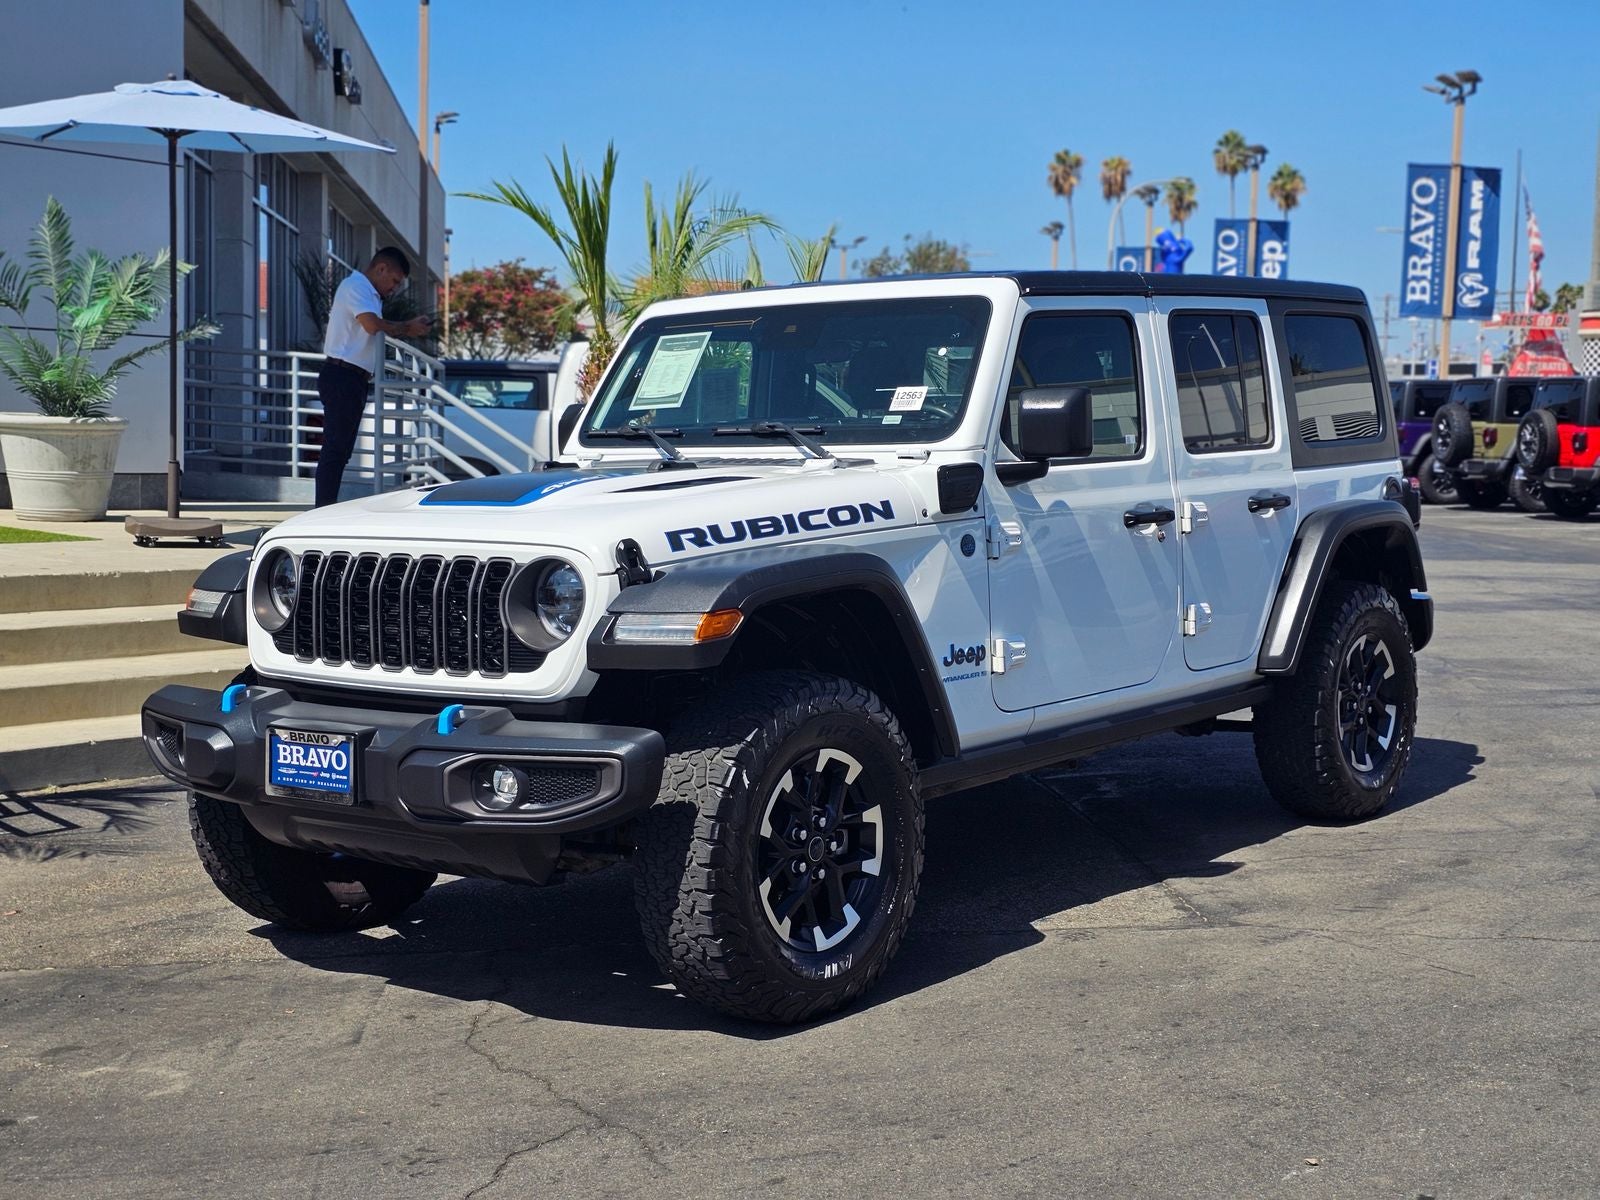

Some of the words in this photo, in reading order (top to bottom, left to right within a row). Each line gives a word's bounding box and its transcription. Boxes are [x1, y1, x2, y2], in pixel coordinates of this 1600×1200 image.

[1466, 180, 1484, 269] RAM
[1406, 177, 1437, 304] BRAVO
[895, 391, 923, 400] 12563
[664, 499, 896, 553] RUBICON
[943, 643, 987, 667] Jeep
[943, 671, 980, 683] WRANGLER
[289, 732, 329, 744] BRAVO
[277, 743, 347, 771] BRAVO
